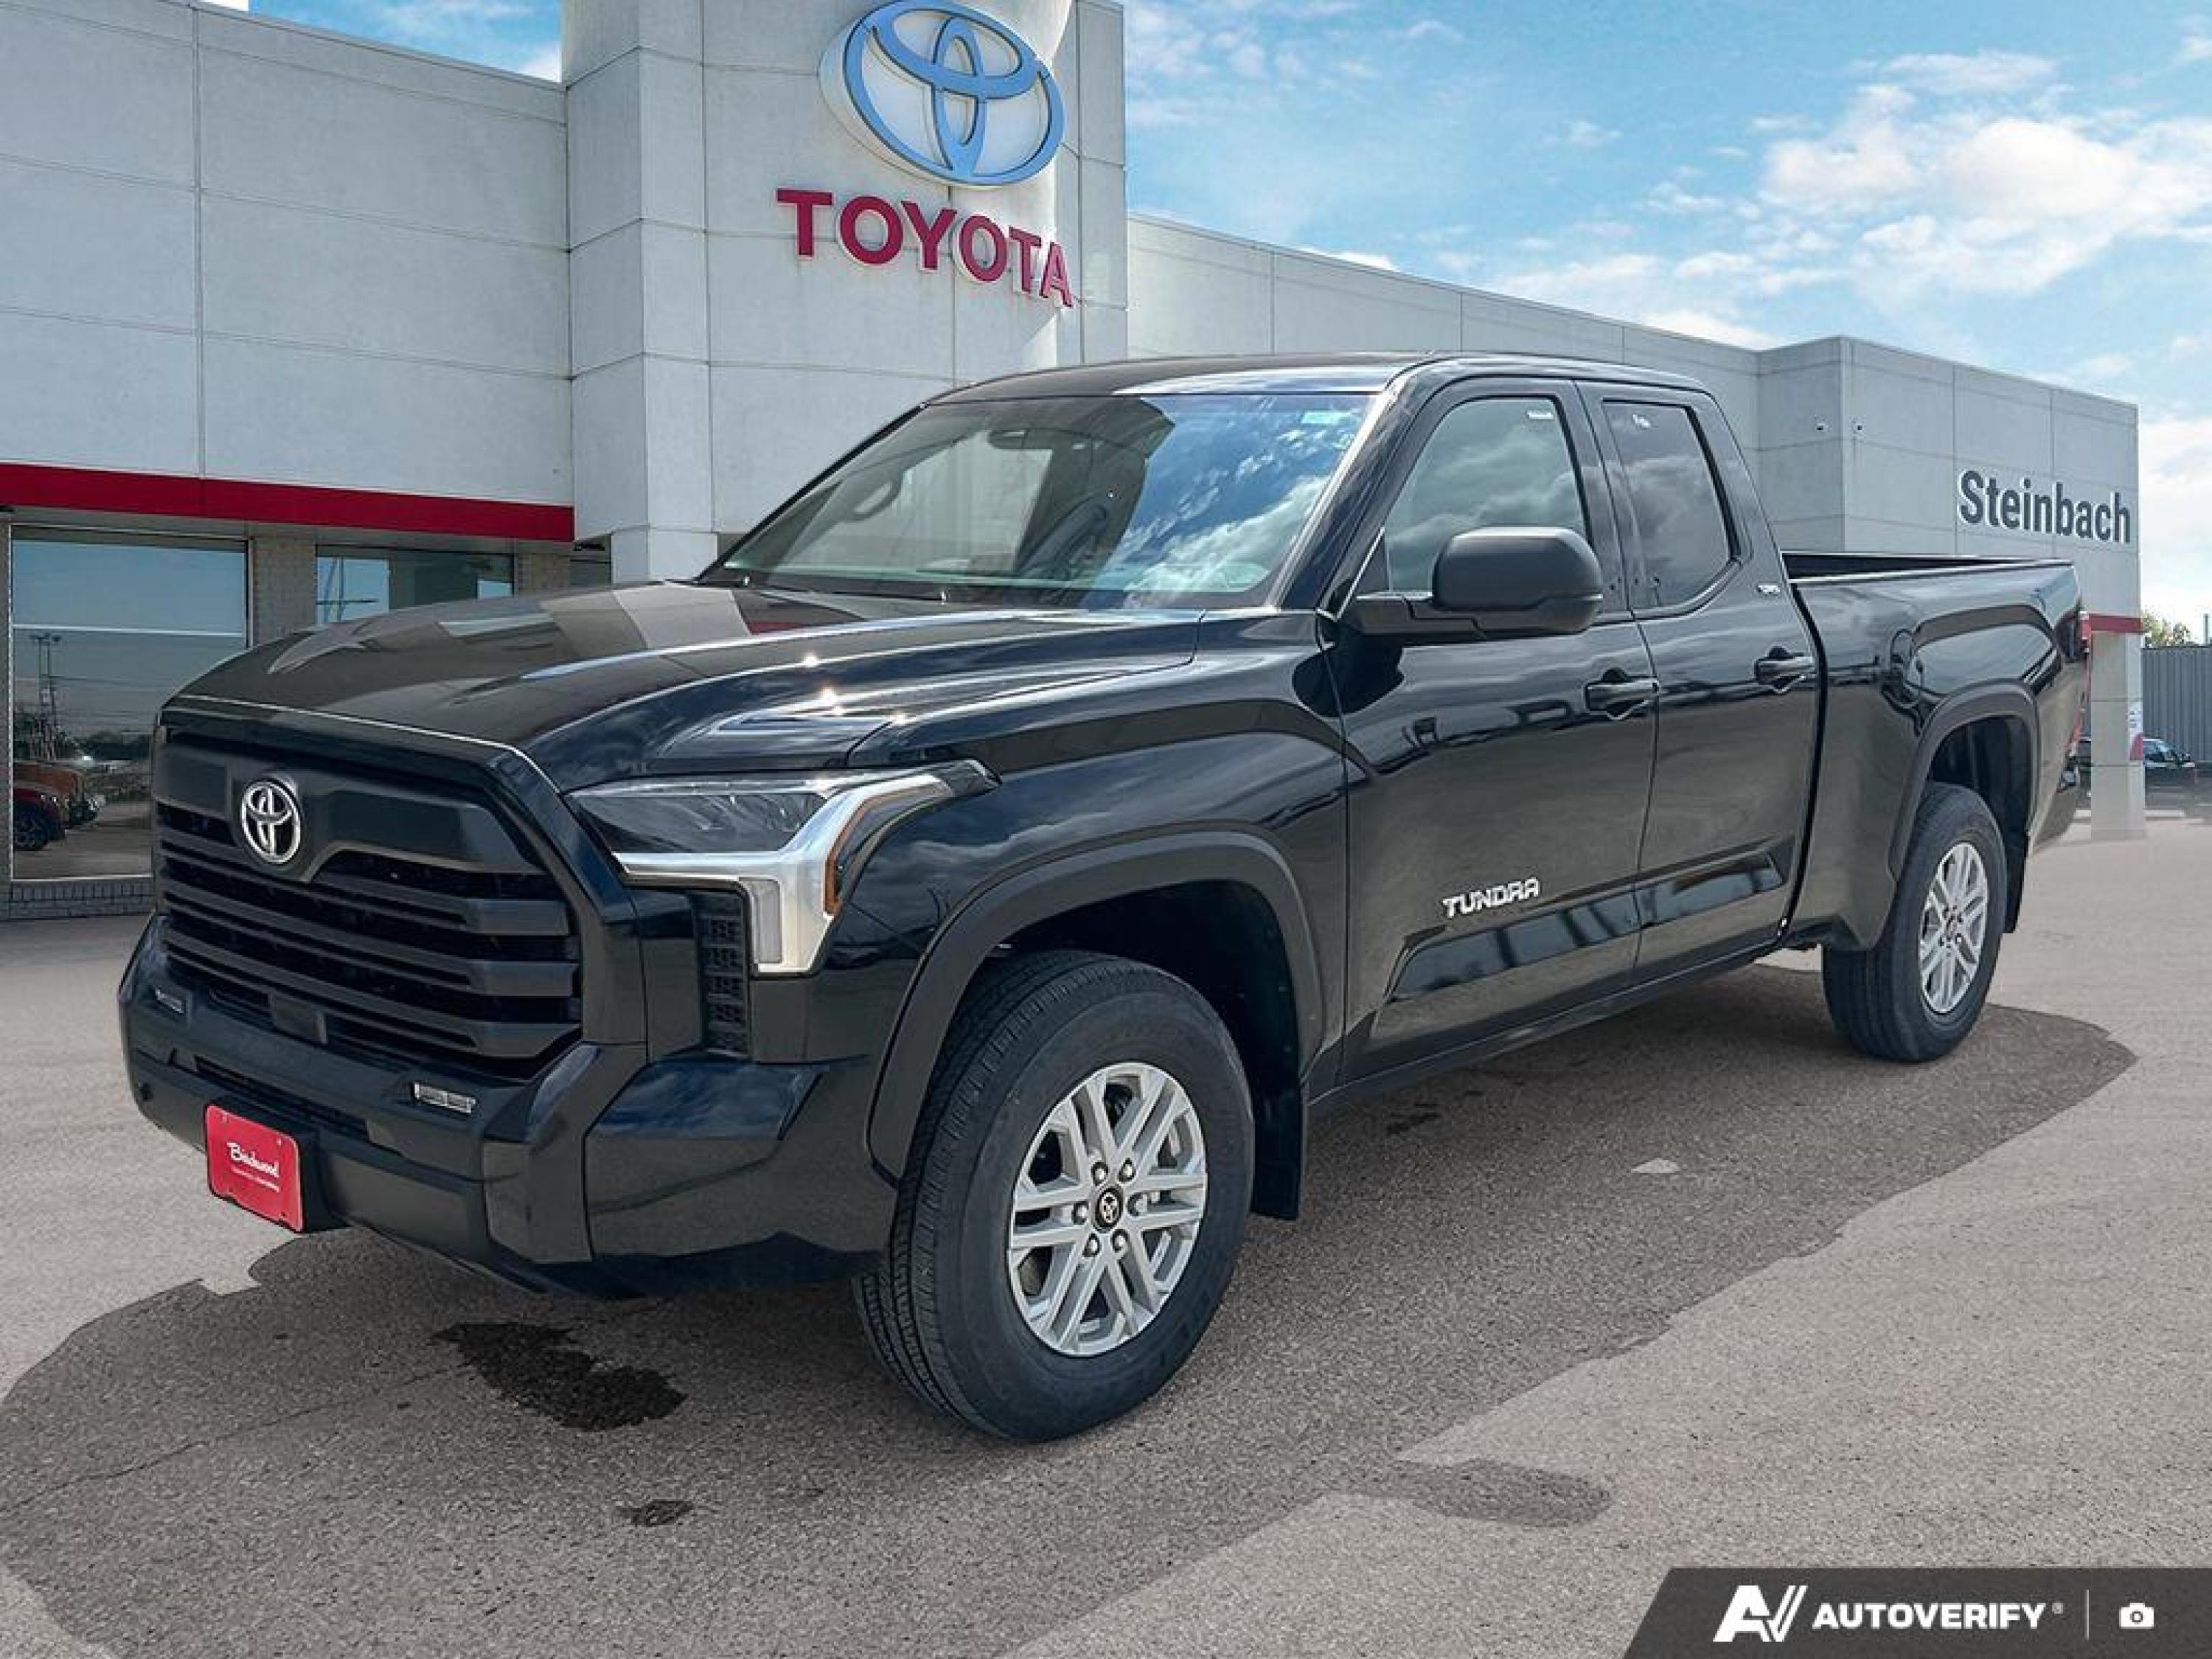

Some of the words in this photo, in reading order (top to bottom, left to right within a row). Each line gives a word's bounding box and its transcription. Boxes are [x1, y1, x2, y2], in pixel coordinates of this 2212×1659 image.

[776, 188, 1074, 307] TOYOTA
[1958, 469, 2131, 543] Steinbach
[1442, 876, 1540, 918] TUNDRA
